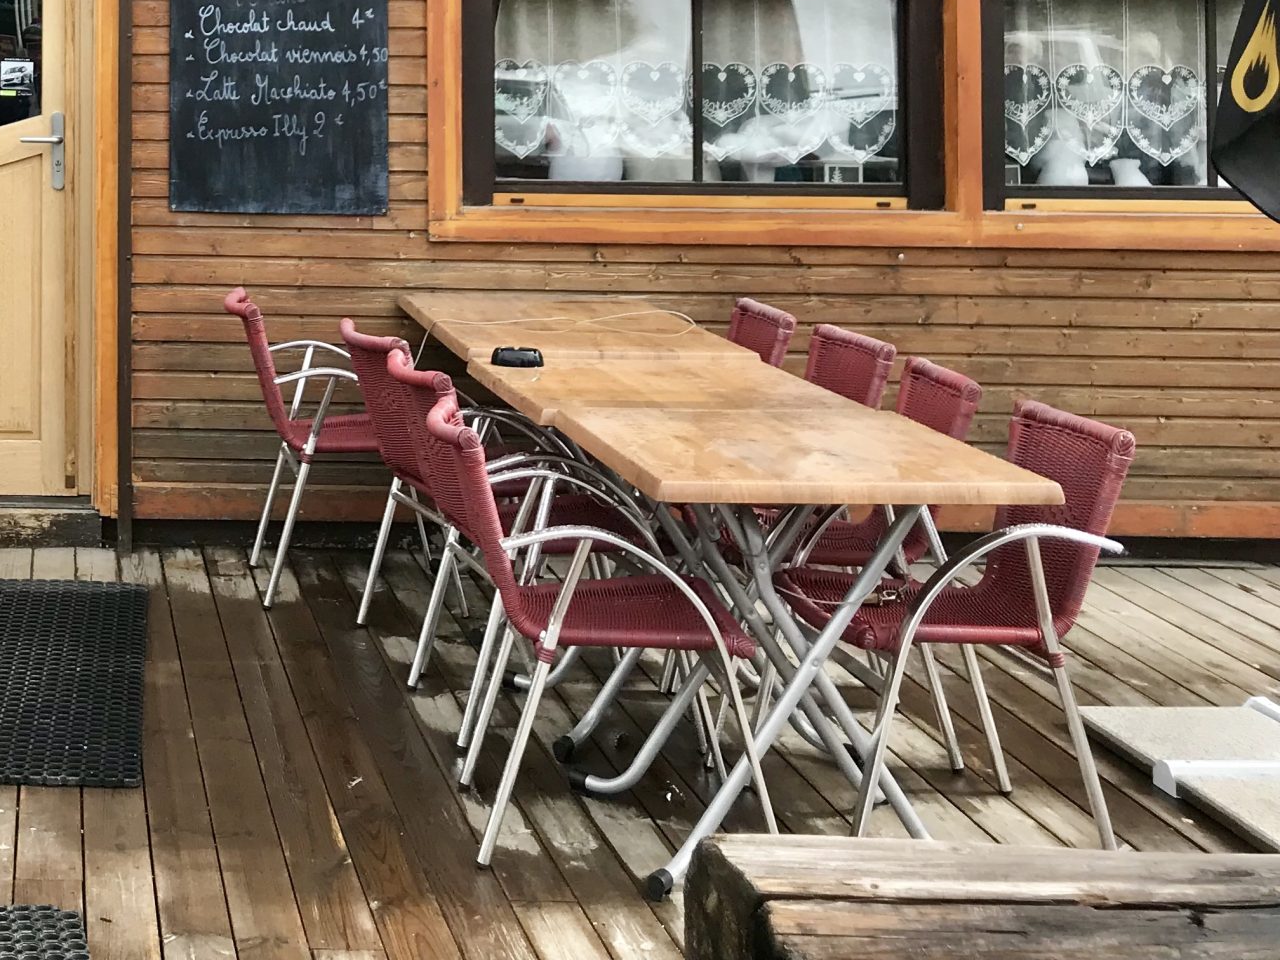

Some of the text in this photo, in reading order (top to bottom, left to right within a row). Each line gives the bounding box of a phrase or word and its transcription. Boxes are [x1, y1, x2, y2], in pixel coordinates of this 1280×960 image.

[198, 4, 270, 37] Chocolat
[276, 8, 336, 33] chaud
[204, 37, 278, 65] Chocolat
[285, 44, 358, 64] viennois
[195, 70, 241, 102] Latte
[251, 73, 336, 106] Macchiato
[272, 114, 309, 157] Illy
